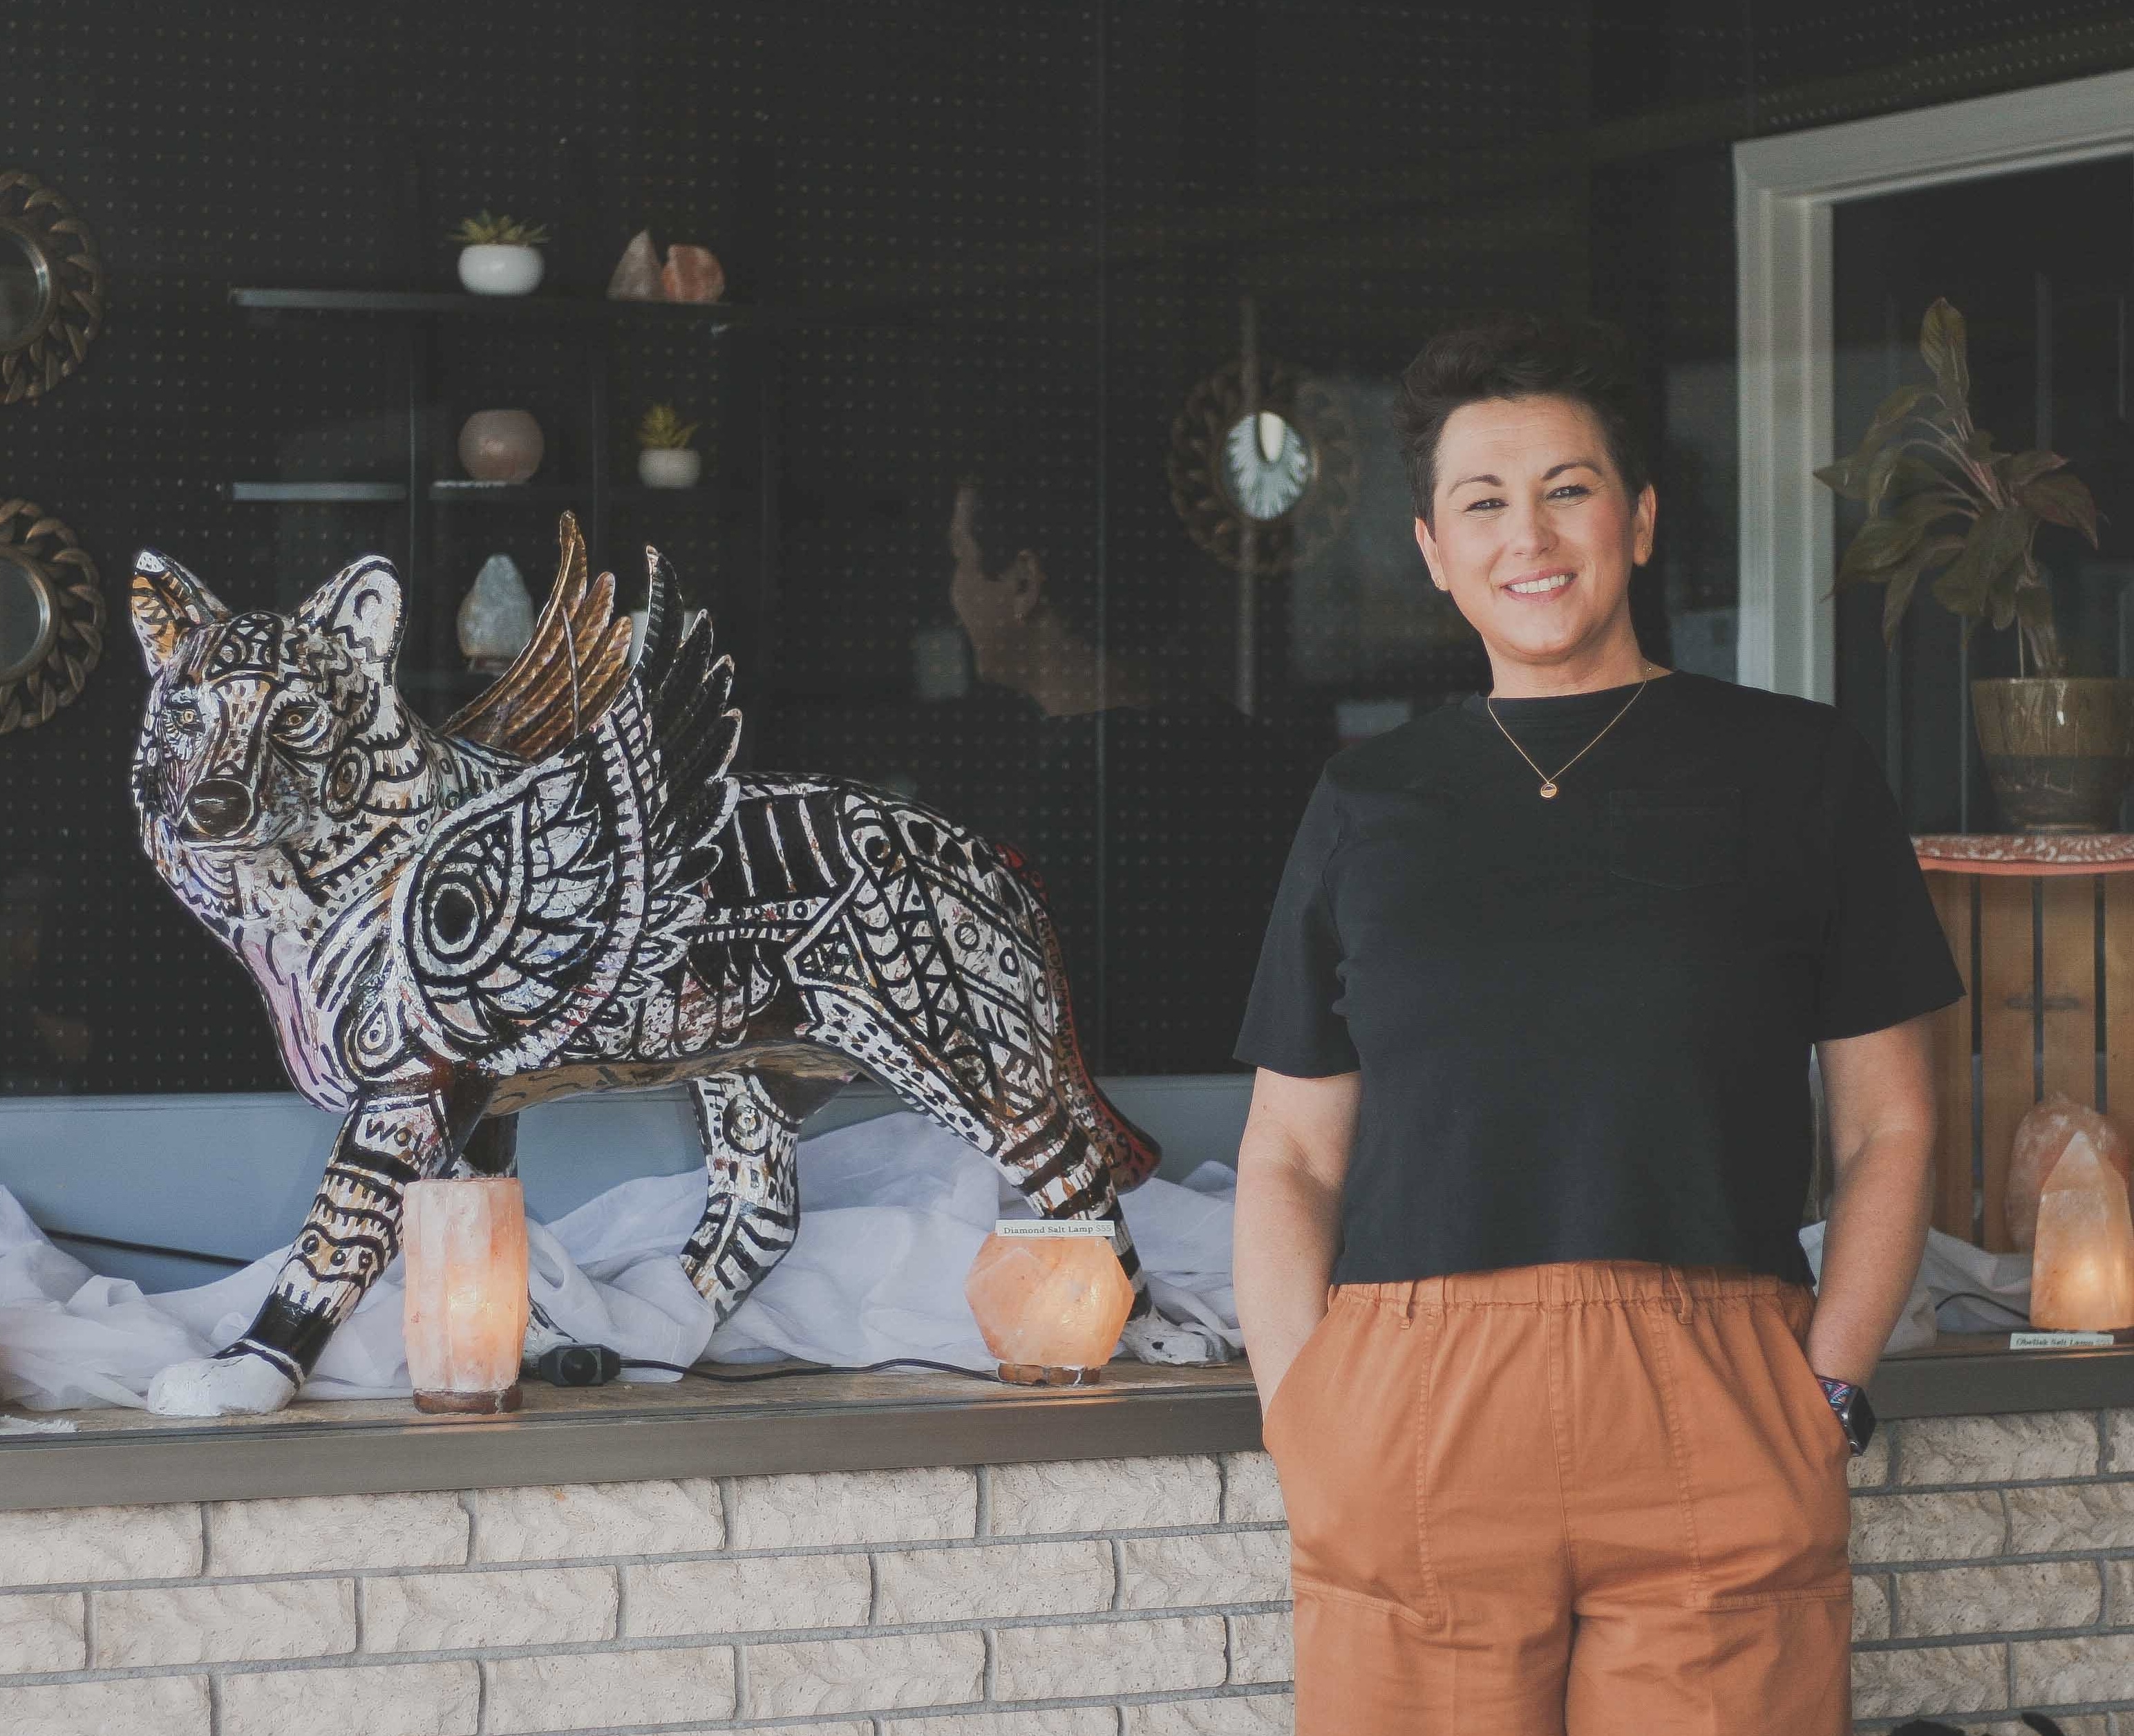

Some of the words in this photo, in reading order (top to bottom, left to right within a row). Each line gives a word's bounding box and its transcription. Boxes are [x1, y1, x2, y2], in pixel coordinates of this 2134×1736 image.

[1003, 1226, 1045, 1234] Diamond
[1048, 1225, 1064, 1234] Salt
[1068, 1226, 1093, 1234] Lamp
